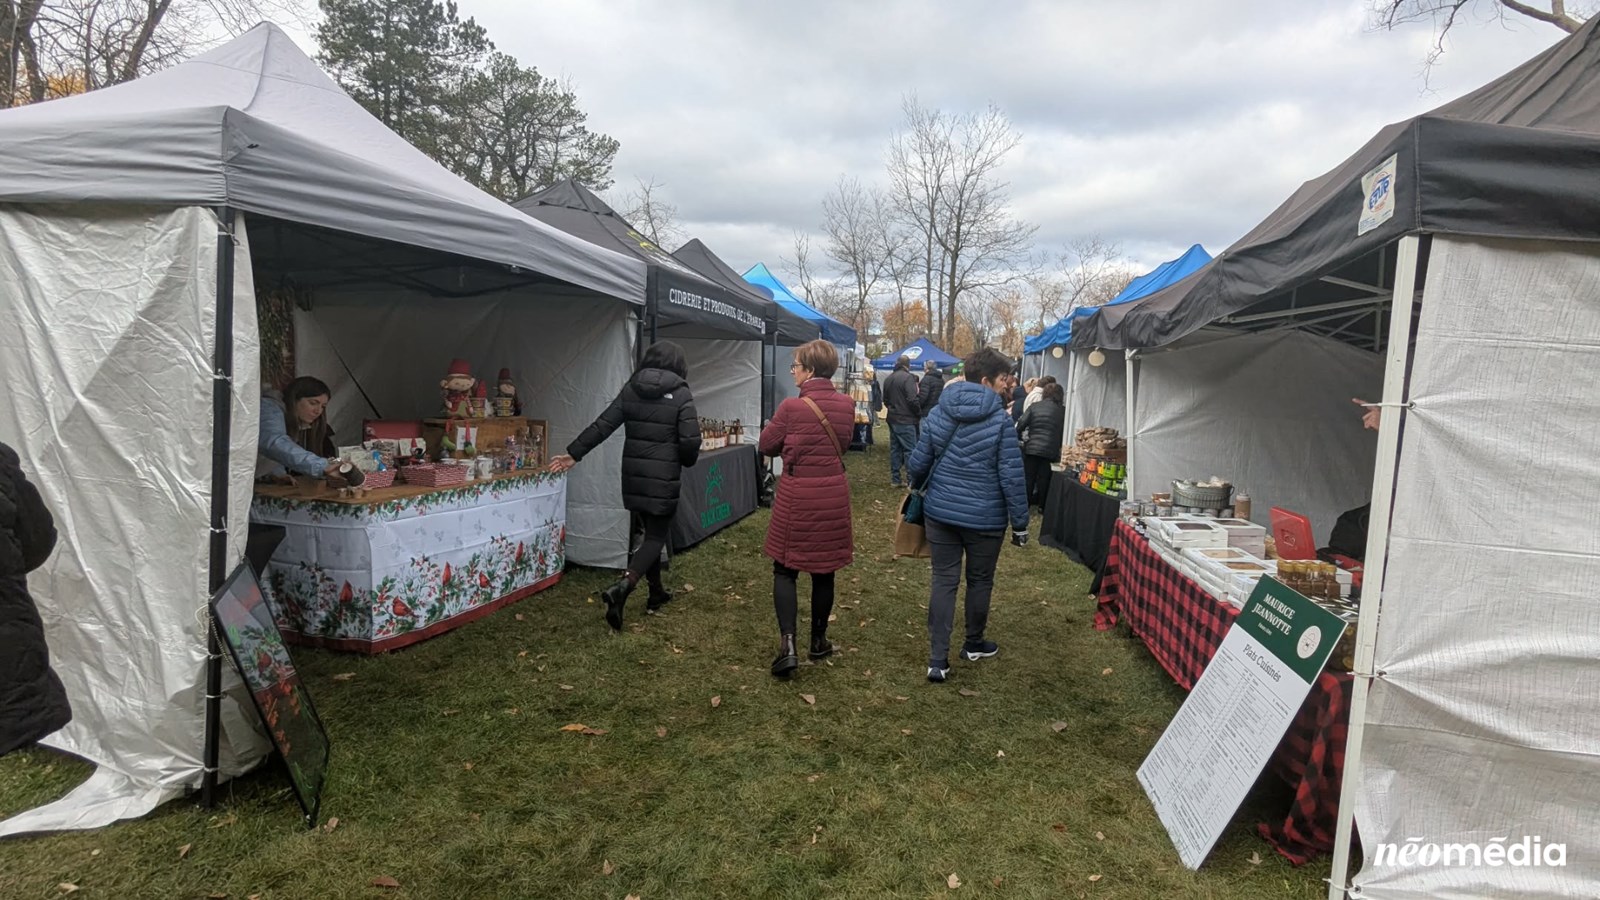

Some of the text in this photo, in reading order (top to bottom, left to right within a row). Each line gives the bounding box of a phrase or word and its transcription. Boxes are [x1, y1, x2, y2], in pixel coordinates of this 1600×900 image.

[669, 288, 702, 310] CIDRERIE
[703, 297, 711, 312] ET
[1252, 603, 1292, 635] JEANNOTTE
[1263, 593, 1296, 620] MAURICE
[1243, 644, 1257, 662] Plats
[1257, 656, 1282, 682] Cuisinés
